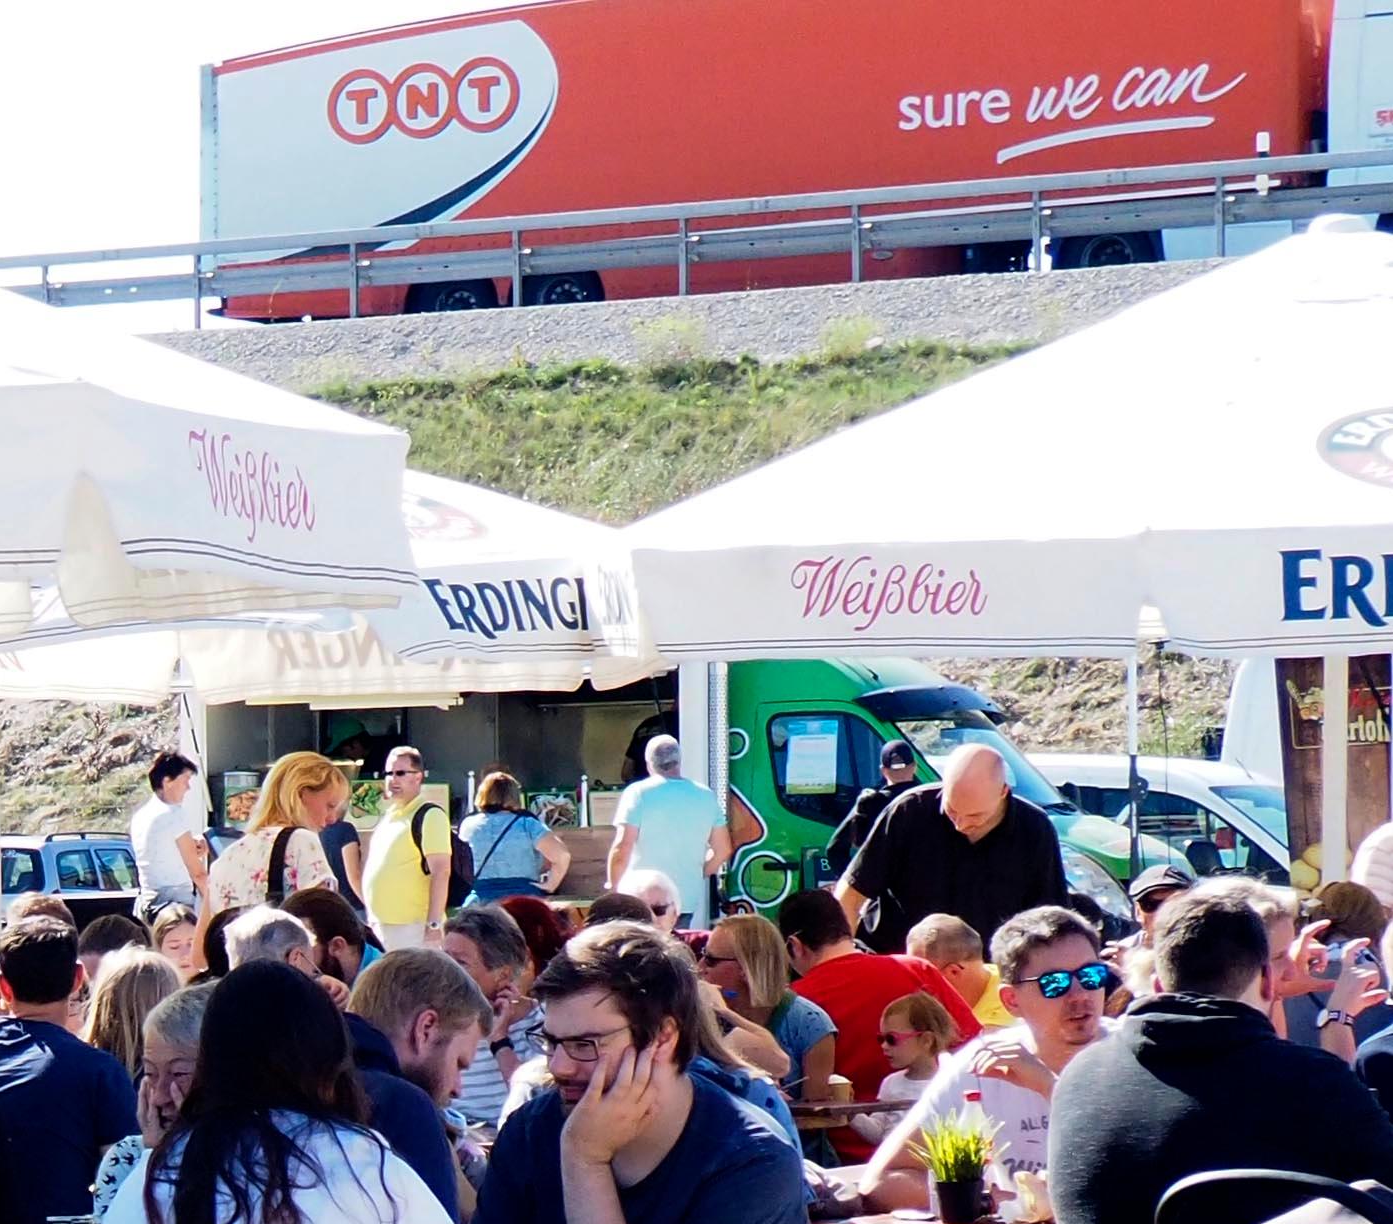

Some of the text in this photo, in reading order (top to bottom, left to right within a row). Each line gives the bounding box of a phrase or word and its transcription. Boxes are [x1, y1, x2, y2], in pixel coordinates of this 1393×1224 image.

[342, 73, 504, 128] TNT
[897, 62, 1248, 131] sure we can
[188, 428, 317, 544] Weißbier
[789, 554, 989, 632] Weißbier
